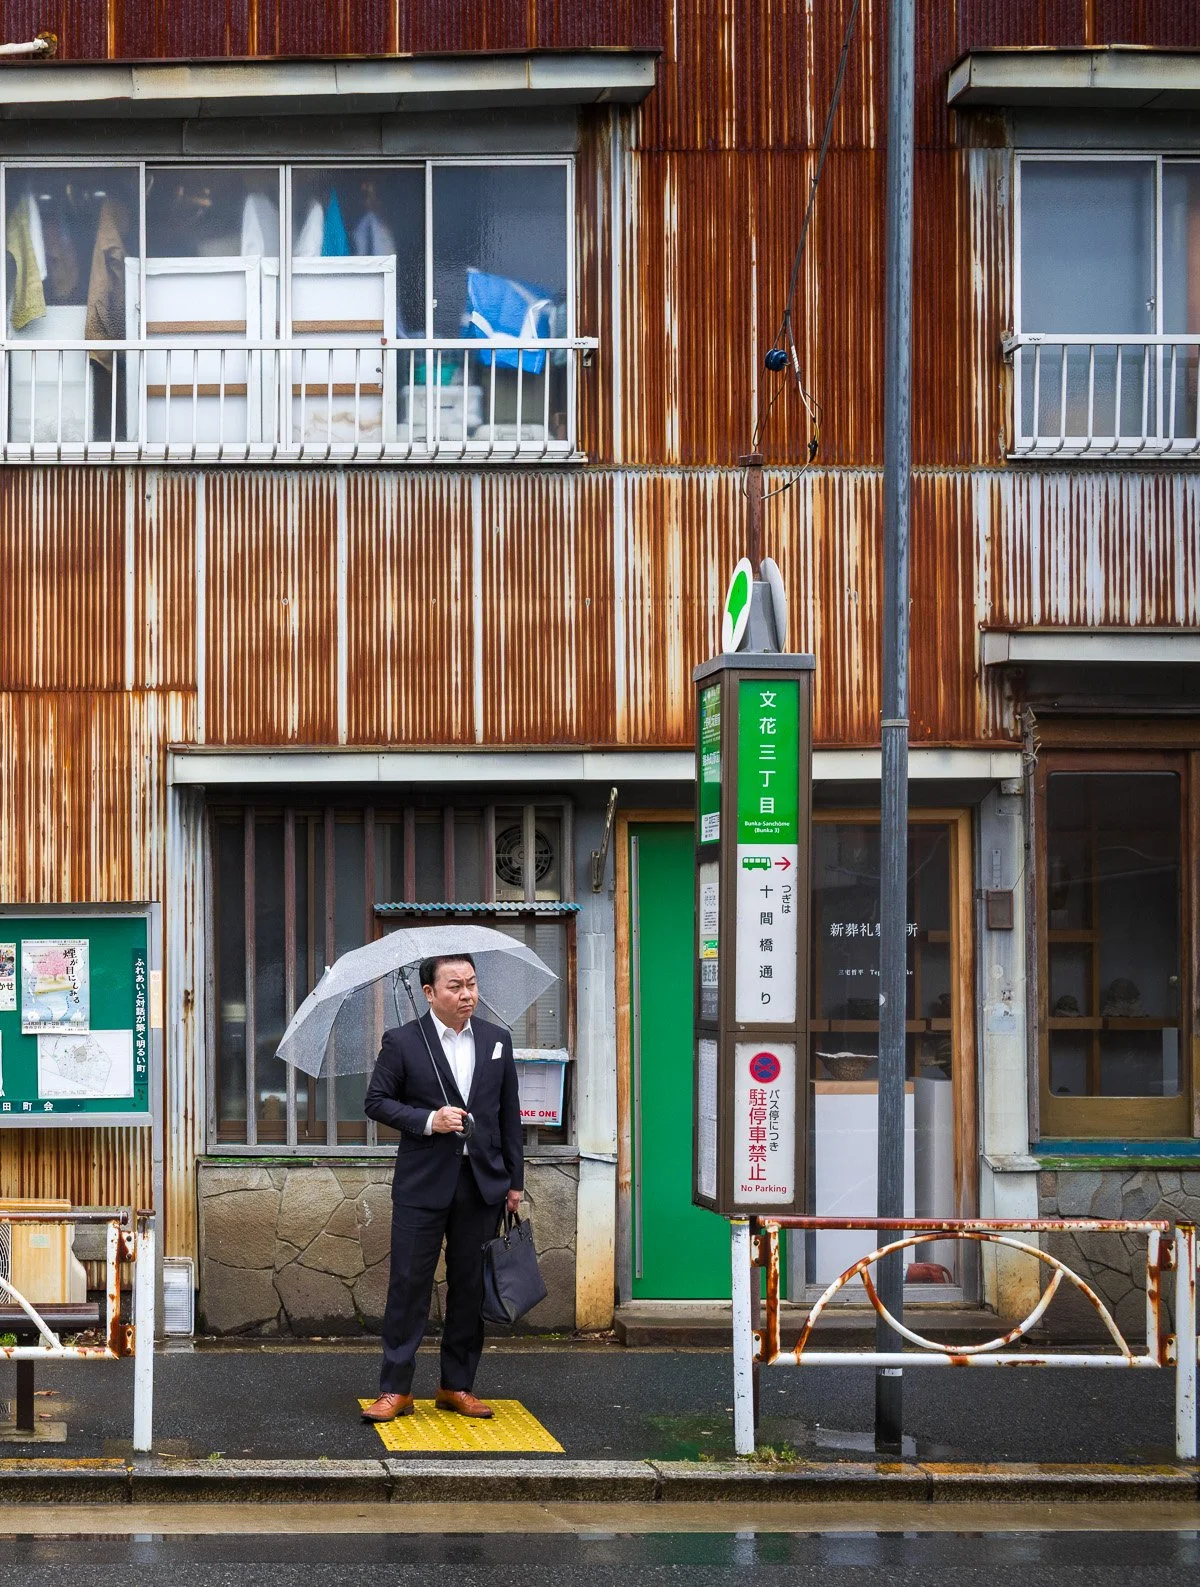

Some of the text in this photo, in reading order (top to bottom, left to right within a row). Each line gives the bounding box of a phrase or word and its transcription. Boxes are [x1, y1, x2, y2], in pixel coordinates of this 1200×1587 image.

[759, 691, 777, 814] 文花三丁目
[781, 885, 792, 914] つぎは
[830, 923, 918, 937] 新葬礼所
[62, 947, 80, 1004] 煙が目にしみる
[759, 884, 774, 1005] 十間橋通り
[135, 957, 146, 1073] ふれあいと対話が築く明るい町
[748, 1088, 767, 1181] 駐停車禁止
[769, 1089, 780, 1152] バス停につき
[740, 1184, 787, 1194] No Parking
